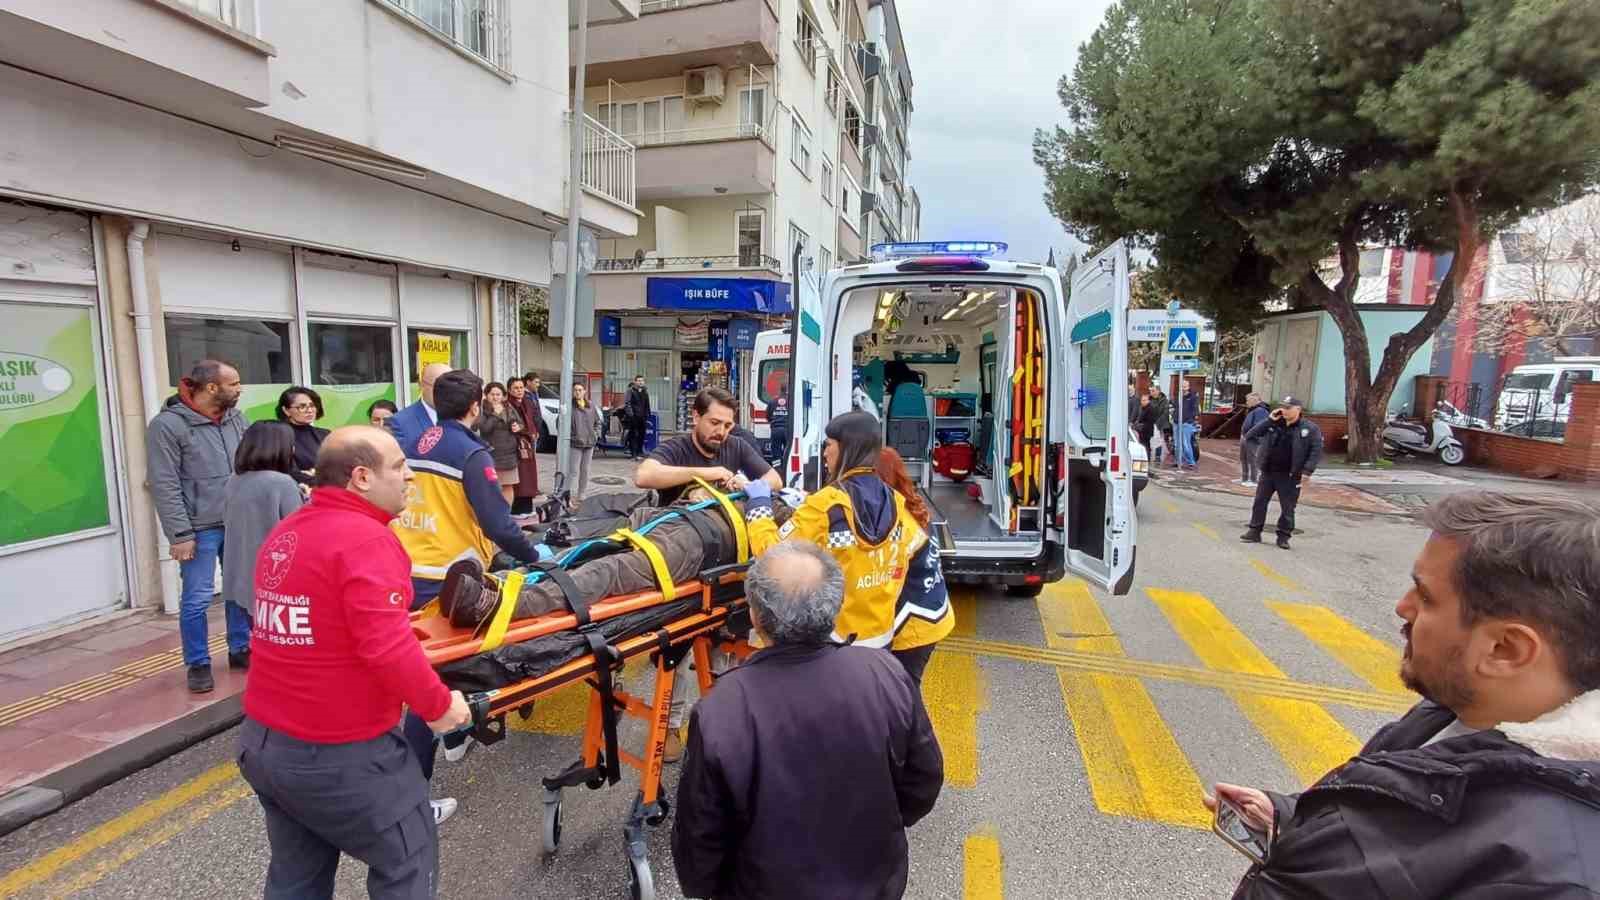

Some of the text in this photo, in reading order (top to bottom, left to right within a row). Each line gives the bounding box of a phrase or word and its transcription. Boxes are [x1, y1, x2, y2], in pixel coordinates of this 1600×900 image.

[685, 287, 729, 300] IŞIK BÜFE
[268, 633, 315, 646] RESCUE
